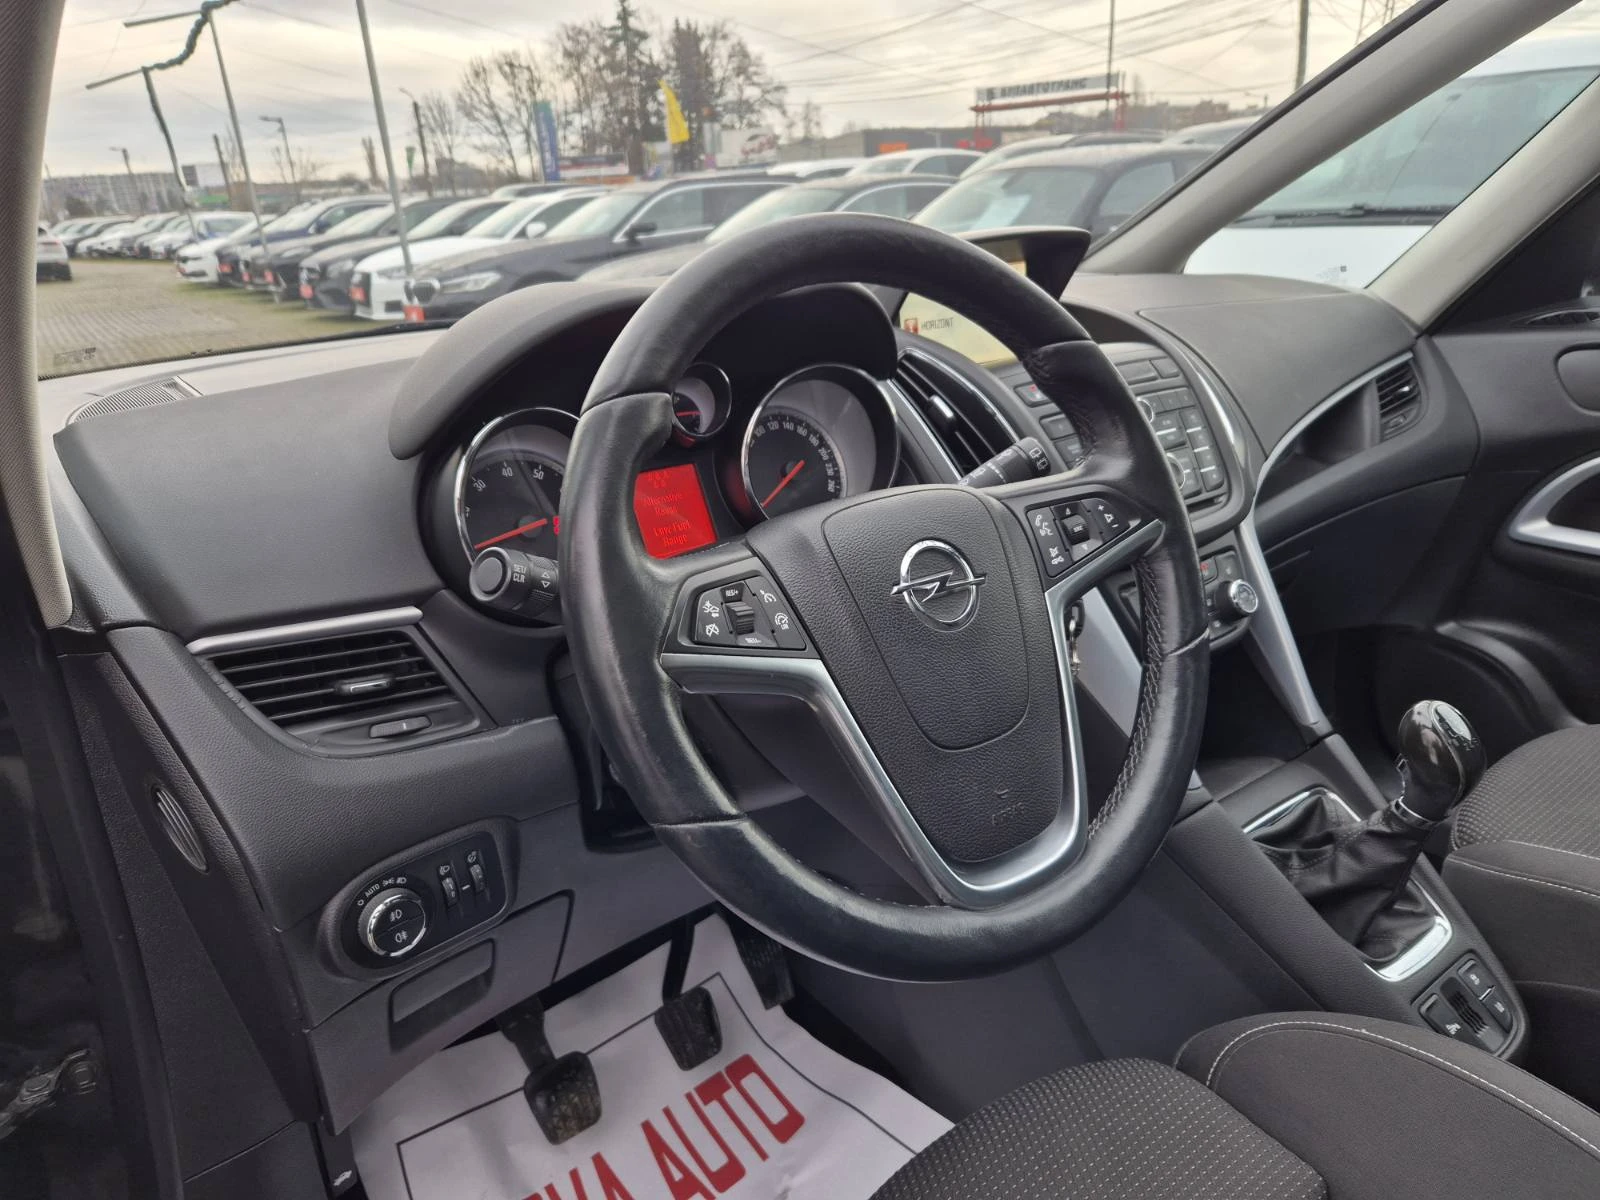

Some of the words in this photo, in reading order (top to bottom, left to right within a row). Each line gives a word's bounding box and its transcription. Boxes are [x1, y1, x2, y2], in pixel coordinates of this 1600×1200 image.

[767, 421, 779, 430] 120
[783, 421, 794, 431] 140
[502, 466, 513, 477] 40
[533, 468, 545, 480] 50
[473, 479, 487, 492] 30
[513, 573, 526, 583] CLR
[365, 883, 380, 898] AUTO
[640, 1054, 806, 1200] AUTO
